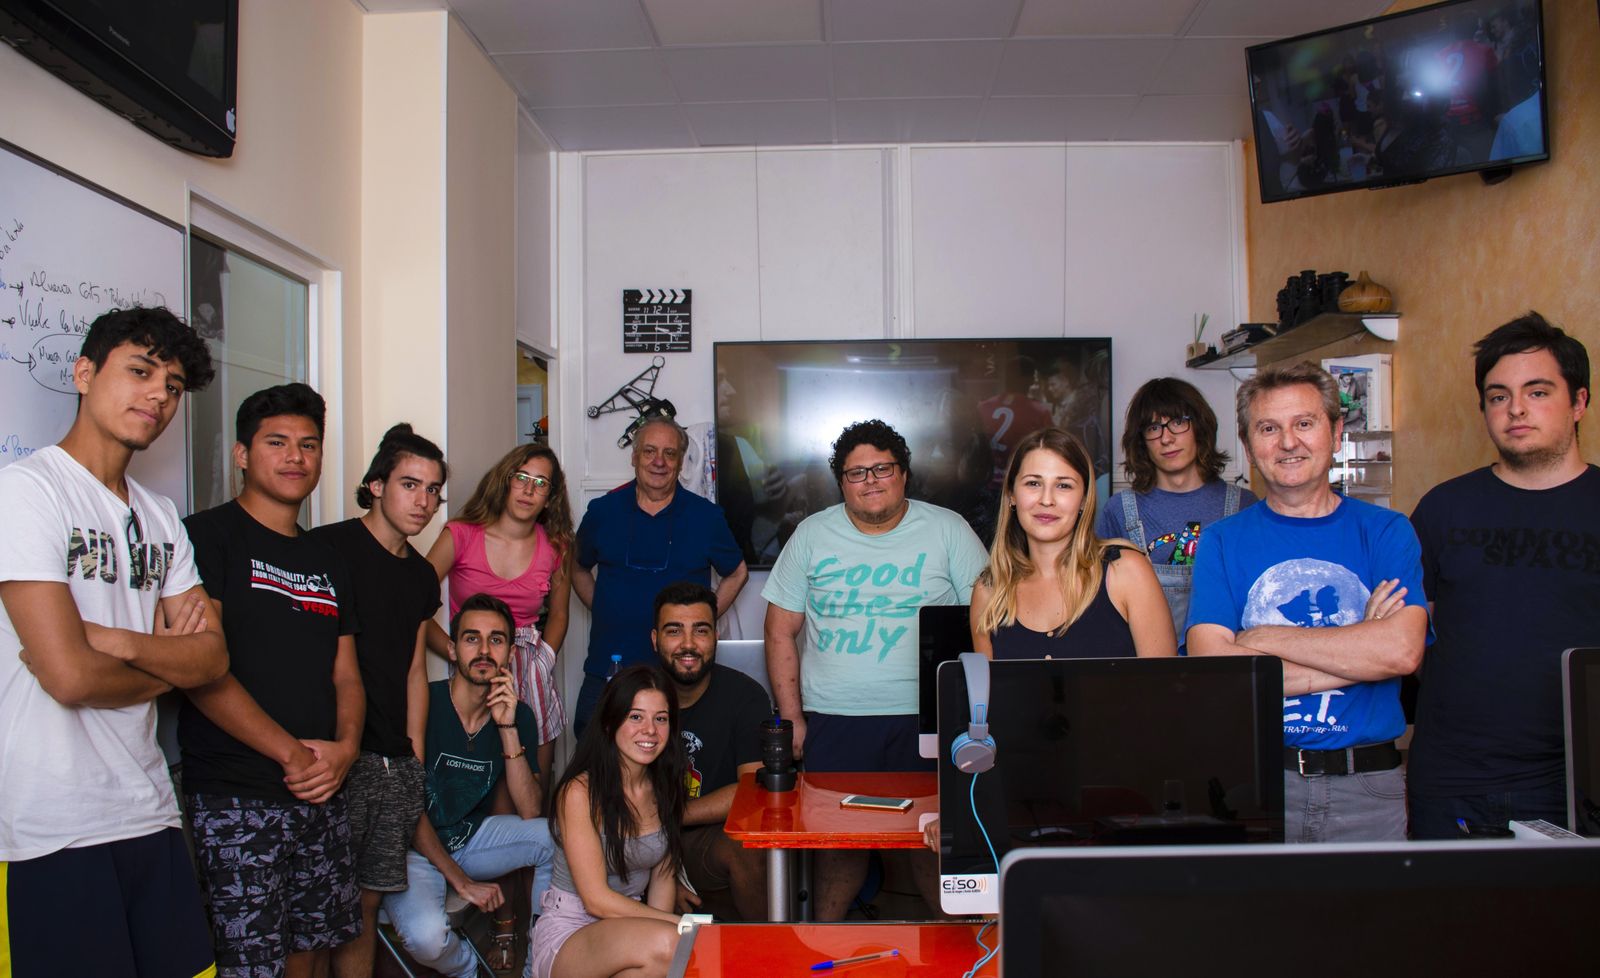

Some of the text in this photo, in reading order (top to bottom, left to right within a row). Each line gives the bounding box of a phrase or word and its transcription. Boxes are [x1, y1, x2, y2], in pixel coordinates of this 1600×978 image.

[653, 305, 663, 315] 12
[632, 324, 638, 333] 9
[677, 324, 683, 333] 3
[654, 342, 660, 352] 6
[992, 407, 1014, 452] 2
[67, 527, 118, 584] NO
[250, 559, 305, 583] THE ORIGINALITY
[252, 569, 307, 592] FROM ITALY SINCE 1946
[811, 553, 927, 587] Good
[810, 588, 928, 619] vibes
[817, 618, 908, 663] only
[446, 759, 462, 768] LOST
